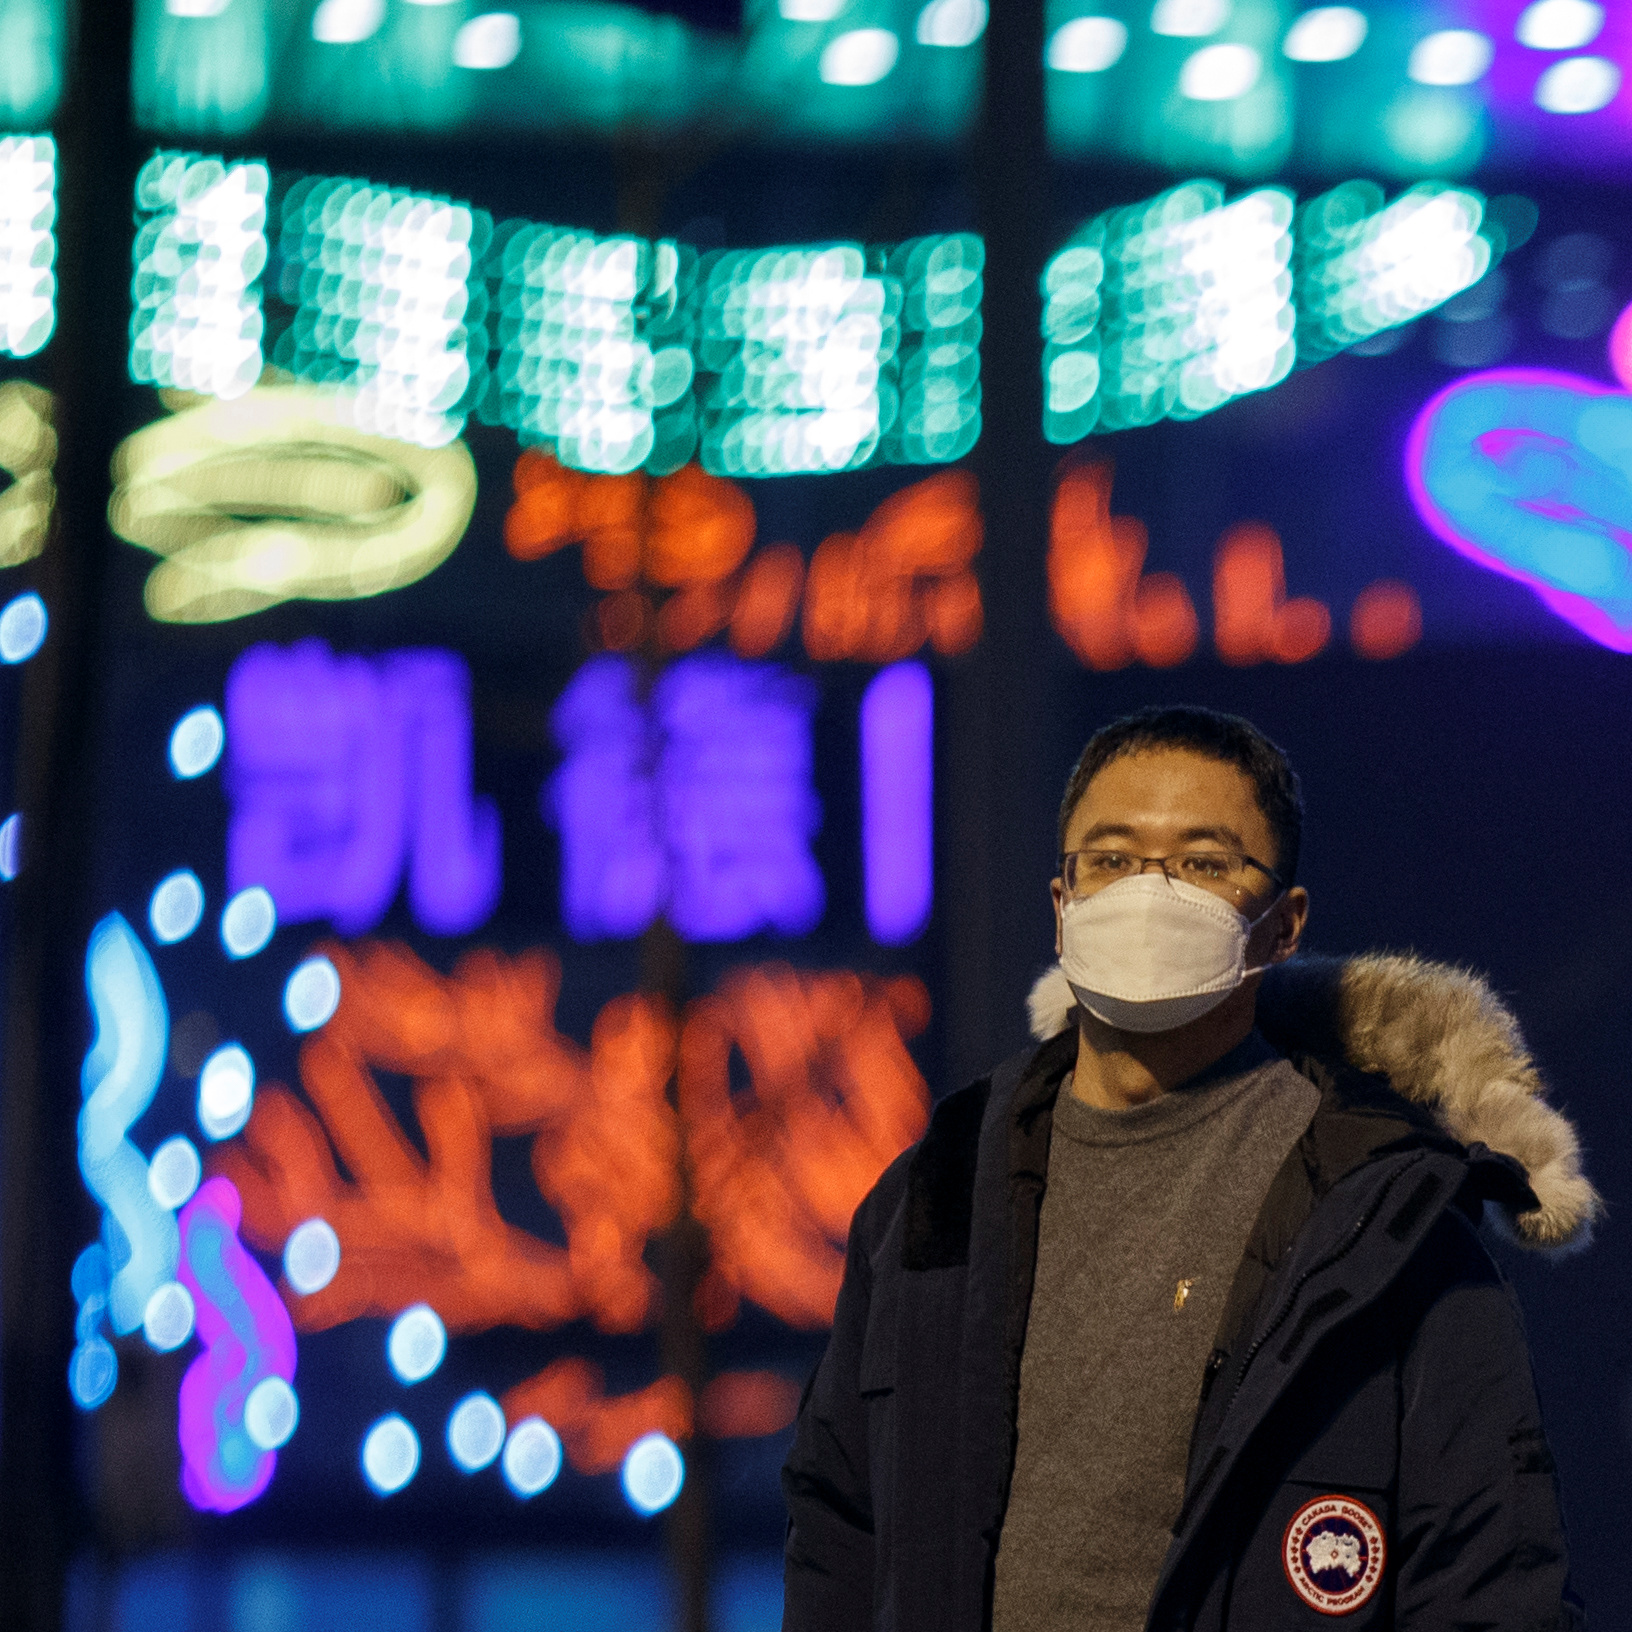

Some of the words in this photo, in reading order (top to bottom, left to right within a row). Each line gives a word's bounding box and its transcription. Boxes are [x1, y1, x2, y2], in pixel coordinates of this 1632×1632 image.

[1302, 1504, 1337, 1526] CANADA
[1299, 1577, 1324, 1603] ARCTIC
[1327, 1586, 1365, 1605] PROGRAM
